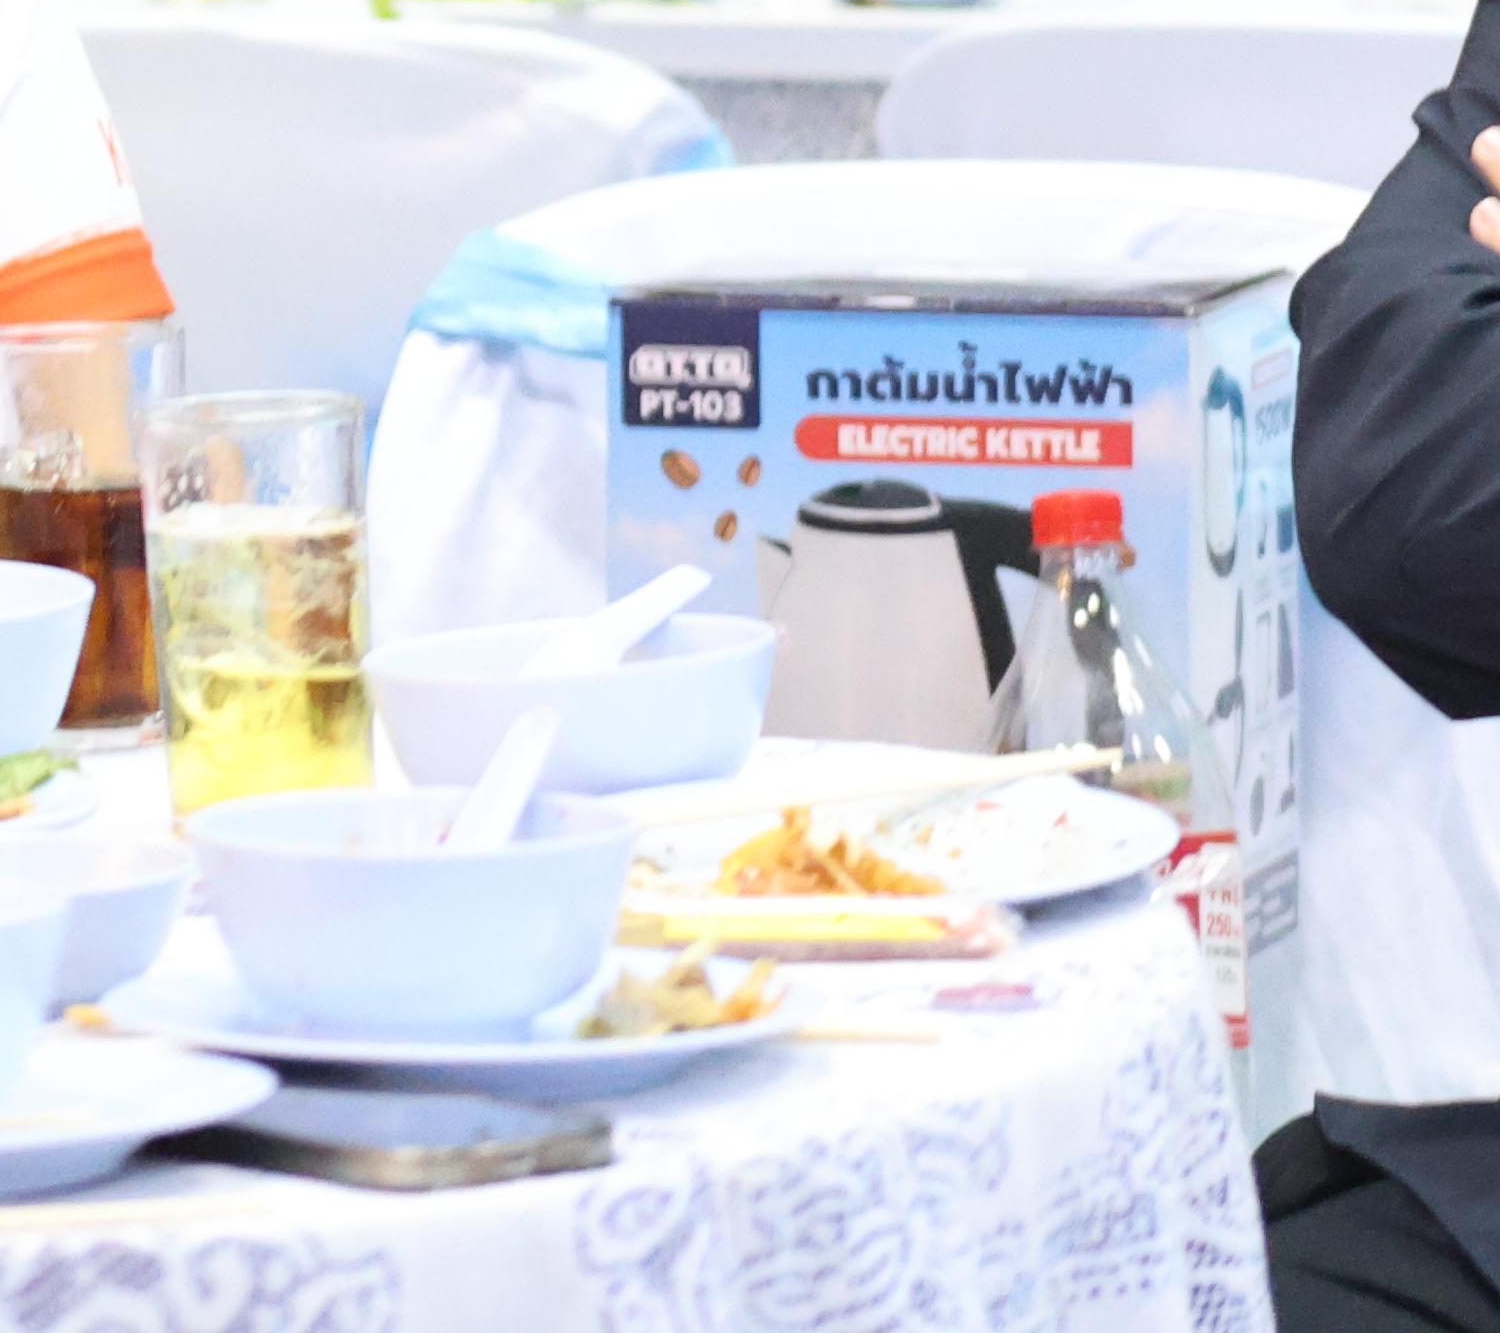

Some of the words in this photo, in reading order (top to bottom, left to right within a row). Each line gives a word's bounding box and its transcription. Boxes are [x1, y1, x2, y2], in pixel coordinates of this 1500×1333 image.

[806, 340, 1134, 407] กาต้มน้ำไฟฟ้า
[639, 388, 744, 423] PT-103
[836, 423, 979, 459] ELECTRIC
[985, 427, 1102, 462] KETTLE
